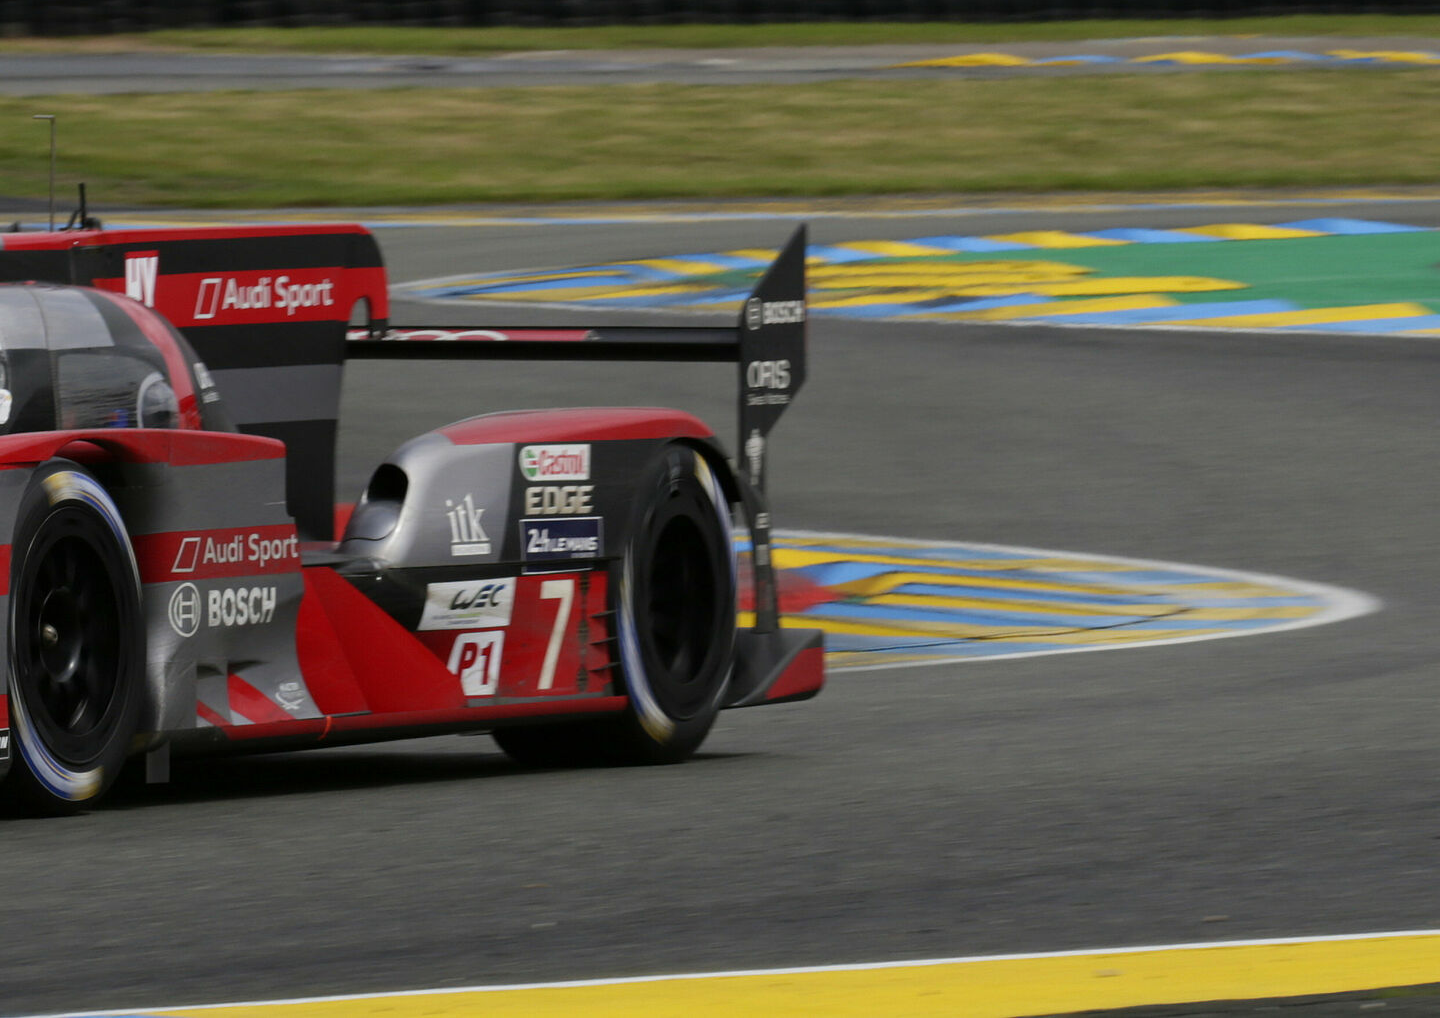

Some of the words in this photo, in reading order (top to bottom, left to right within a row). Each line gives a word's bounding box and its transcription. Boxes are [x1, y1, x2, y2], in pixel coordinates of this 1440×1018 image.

[222, 277, 272, 310] Audi
[274, 275, 333, 316] Sport
[445, 493, 490, 543] itk
[525, 485, 595, 515] EDGE
[202, 535, 244, 564] Audi
[247, 533, 299, 568] Sport
[208, 587, 276, 627] BOSCH
[449, 584, 506, 610] WEC
[536, 579, 575, 690] 7
[461, 641, 495, 685] P1
